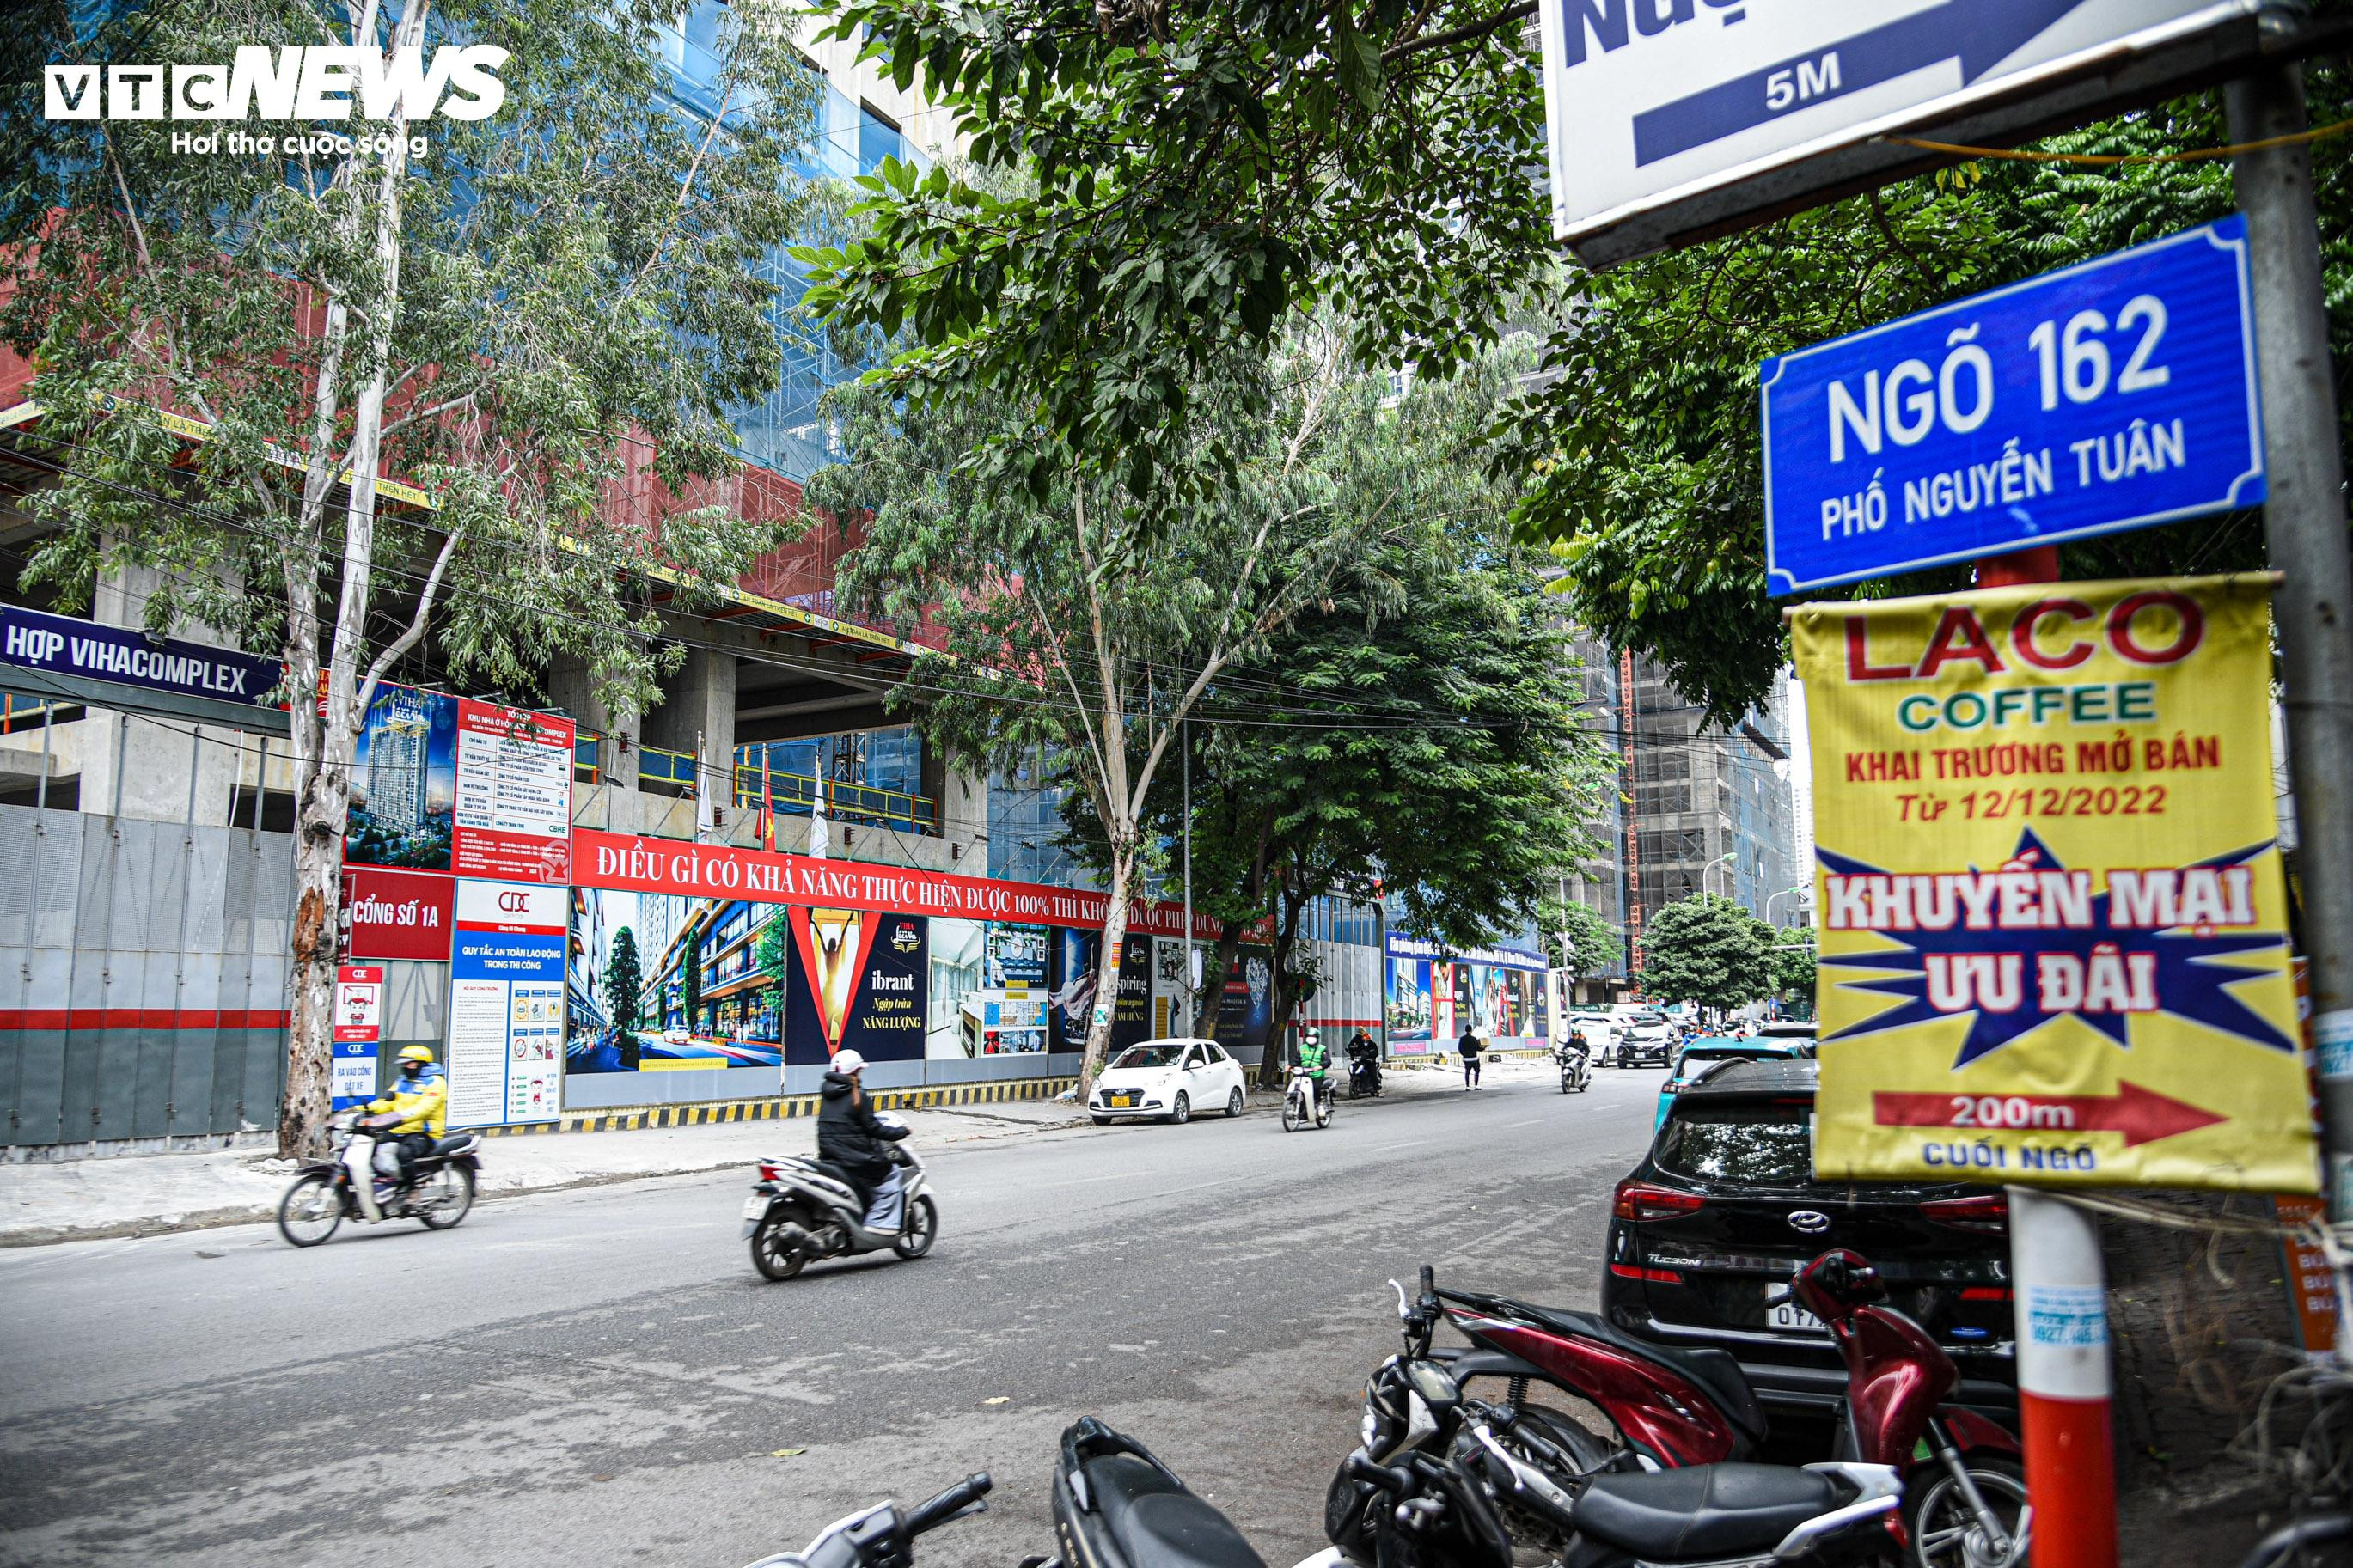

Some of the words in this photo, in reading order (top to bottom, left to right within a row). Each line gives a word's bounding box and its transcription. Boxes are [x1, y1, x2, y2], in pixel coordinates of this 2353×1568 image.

[1764, 52, 1842, 111] 5M
[1827, 321, 1994, 463] NGÕ
[2028, 295, 2170, 412] 162
[1820, 467, 1889, 541] PHỐ
[1904, 437, 2054, 524] NGUYỄN
[2069, 418, 2187, 488] TUÂN
[1844, 589, 2206, 685] LACO
[6, 625, 64, 665] HỢP
[71, 636, 247, 695] VIHACOMPLEX
[468, 713, 480, 723] KHU
[481, 715, 495, 725] NHÀ
[1898, 682, 2157, 733] COFFEE
[1844, 749, 1922, 782] KHAI
[1932, 741, 2063, 779] TRƯƠNG
[2077, 730, 2133, 774] MỞ
[2148, 730, 2220, 772] BÁN
[1896, 791, 1947, 822] Từ
[1960, 785, 2167, 819] 12/12/2022
[548, 825, 566, 833] CBRE
[597, 839, 663, 881] ĐIỀU
[671, 848, 700, 885] GÌ
[706, 853, 739, 888] CÓ
[745, 859, 795, 894] KHẢ
[800, 866, 857, 899] NĂNG
[862, 875, 915, 909] THỰC
[919, 880, 962, 913] HIỆN
[965, 886, 1011, 918] ĐƯỢC
[1014, 894, 1049, 917] 100%
[1052, 895, 1078, 919] THÌ
[1824, 846, 2095, 930] KHUYẾN
[2107, 863, 2258, 939] MẠI
[353, 893, 394, 925] CỔNG
[396, 899, 420, 926] SỐ
[422, 906, 438, 928] 1A
[462, 946, 479, 956] QUY
[479, 943, 494, 956] TẮC
[494, 948, 505, 956] AN
[506, 947, 527, 957] TOÀN
[527, 949, 541, 958] LAO
[541, 948, 561, 960] ĐỘNG
[483, 960, 509, 969] TRONG
[509, 961, 520, 969] THI
[521, 959, 541, 970] CÔNG
[871, 969, 914, 991] ibrant
[1116, 974, 1147, 995] spiring
[1922, 952, 2025, 1014] ƯU
[2037, 941, 2160, 1014] ĐÃI
[872, 997, 894, 1012] Ngập
[862, 1016, 889, 1029] NĂNG
[889, 1015, 920, 1031] LƯỢNG
[1949, 1095, 2075, 1129] 200m
[1922, 1136, 2008, 1168] CUỐI
[2020, 1140, 2096, 1171] NGÕ
[1647, 1254, 1701, 1267] TUCSON
